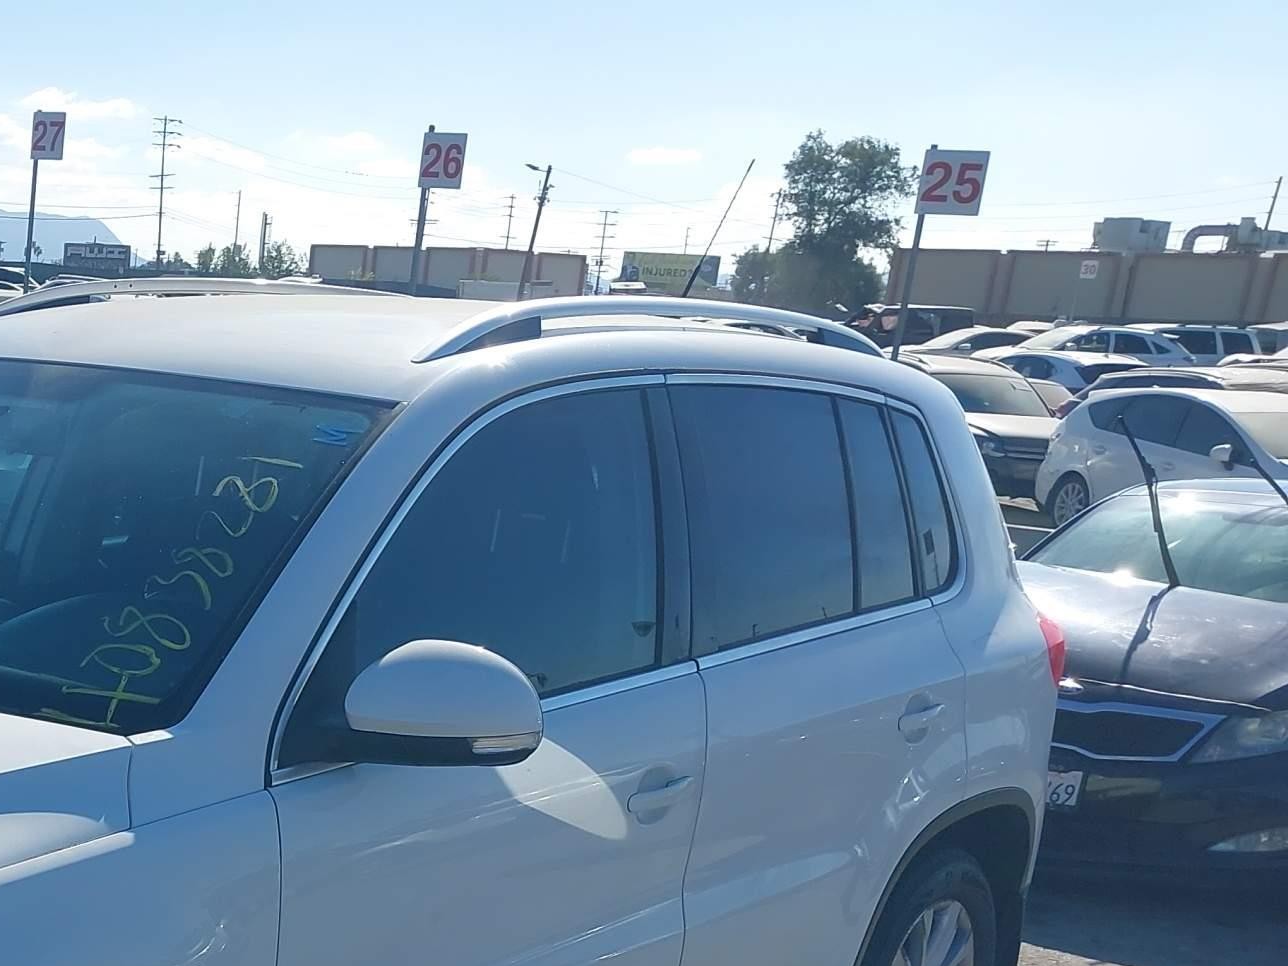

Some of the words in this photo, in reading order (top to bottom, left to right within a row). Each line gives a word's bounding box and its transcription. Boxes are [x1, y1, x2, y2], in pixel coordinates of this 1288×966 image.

[32, 120, 65, 151] 27
[421, 143, 463, 179] 26
[919, 161, 984, 204] 25
[1048, 781, 1076, 805] 69
